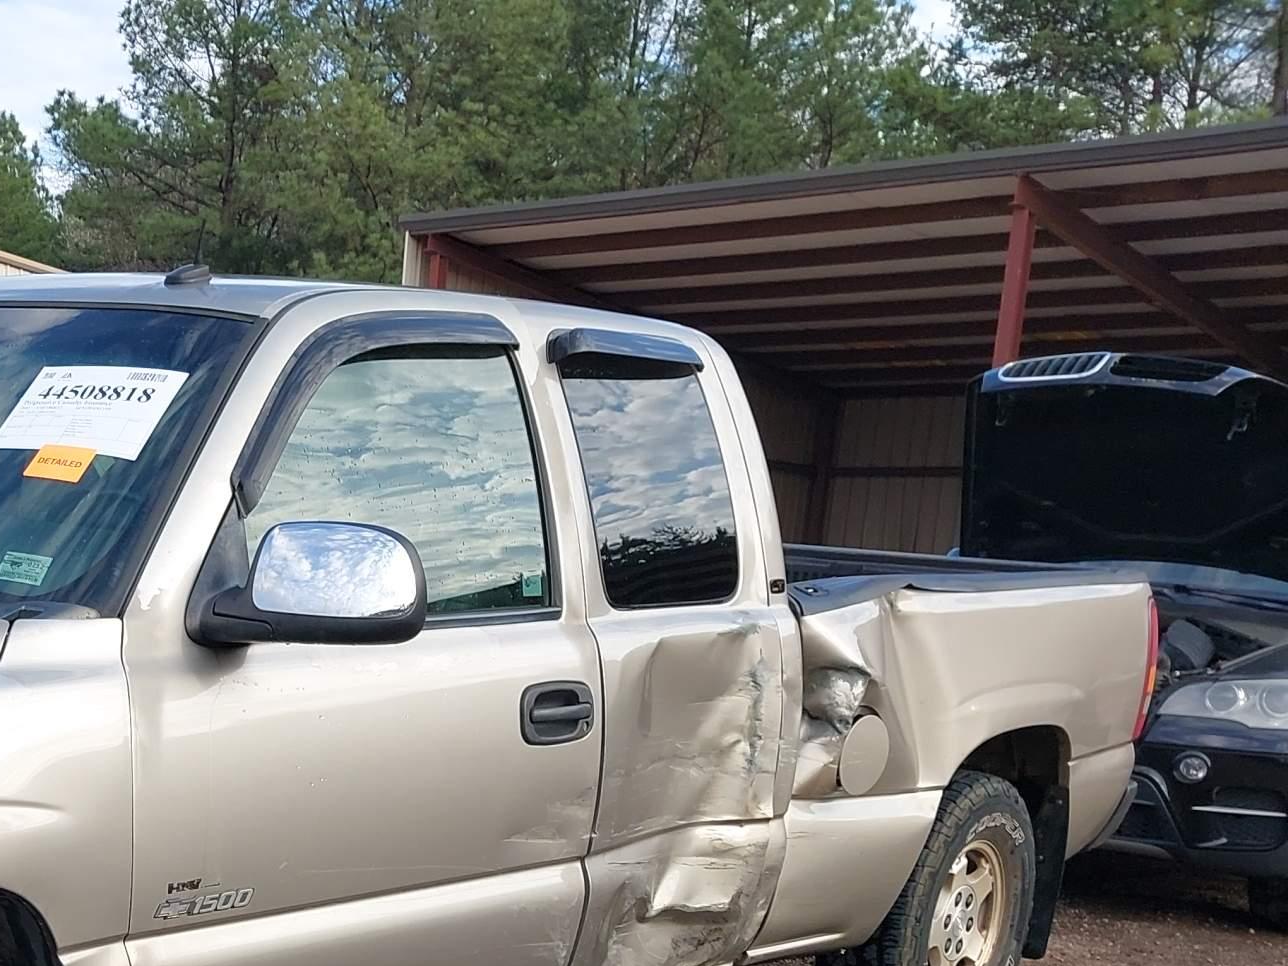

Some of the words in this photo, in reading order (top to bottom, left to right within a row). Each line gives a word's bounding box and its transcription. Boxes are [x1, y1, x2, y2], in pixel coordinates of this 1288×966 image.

[38, 384, 157, 403] 44508818
[37, 457, 82, 468] DETAILED
[966, 812, 1025, 846] COOPER
[192, 888, 255, 915] 1500
